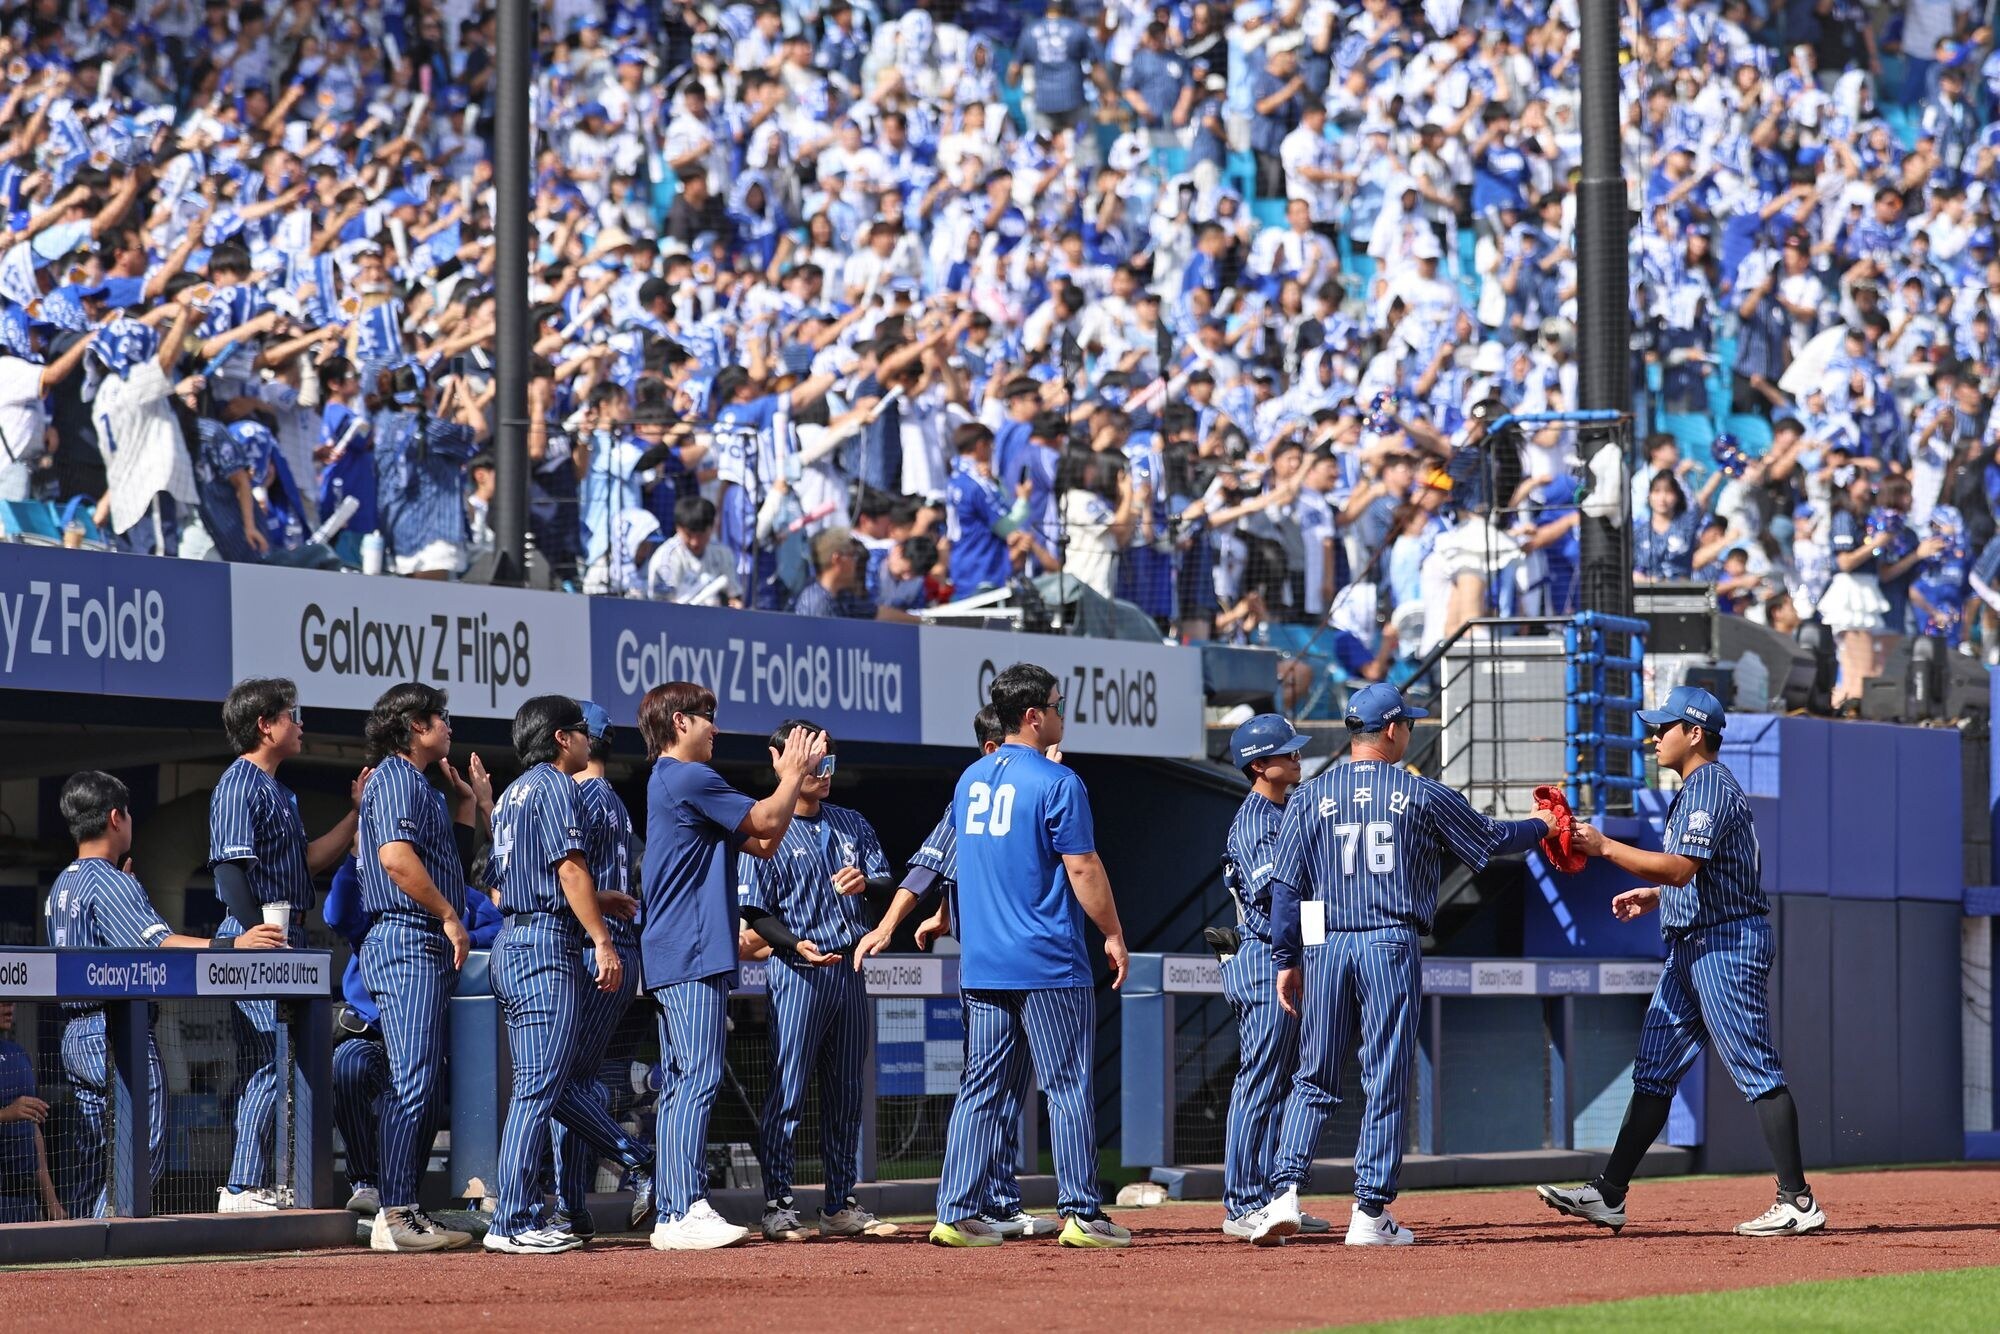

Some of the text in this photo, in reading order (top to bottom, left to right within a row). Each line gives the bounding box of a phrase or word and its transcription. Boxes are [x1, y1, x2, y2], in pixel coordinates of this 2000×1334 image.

[30, 580, 52, 655] Z
[61, 582, 166, 663] Fold8
[301, 603, 531, 708] Galaxy Z Flip8
[616, 628, 725, 719] Galaxy
[728, 638, 746, 703] Z
[751, 640, 831, 711] Fold8
[836, 648, 902, 714] Ultra
[1073, 666, 1087, 724] Z
[1093, 666, 1158, 728] Fold8
[965, 781, 1016, 837] 20
[1333, 821, 1395, 876] 76
[0, 962, 28, 985] old8
[87, 961, 167, 992] Galaxy Z Flip8
[209, 962, 318, 990] Galaxy Z Fold8 Ultra
[893, 966, 898, 985] Z
[899, 966, 921, 985] Fold8
[1169, 965, 1195, 988] Galaxy
[1196, 966, 1201, 984] Z
